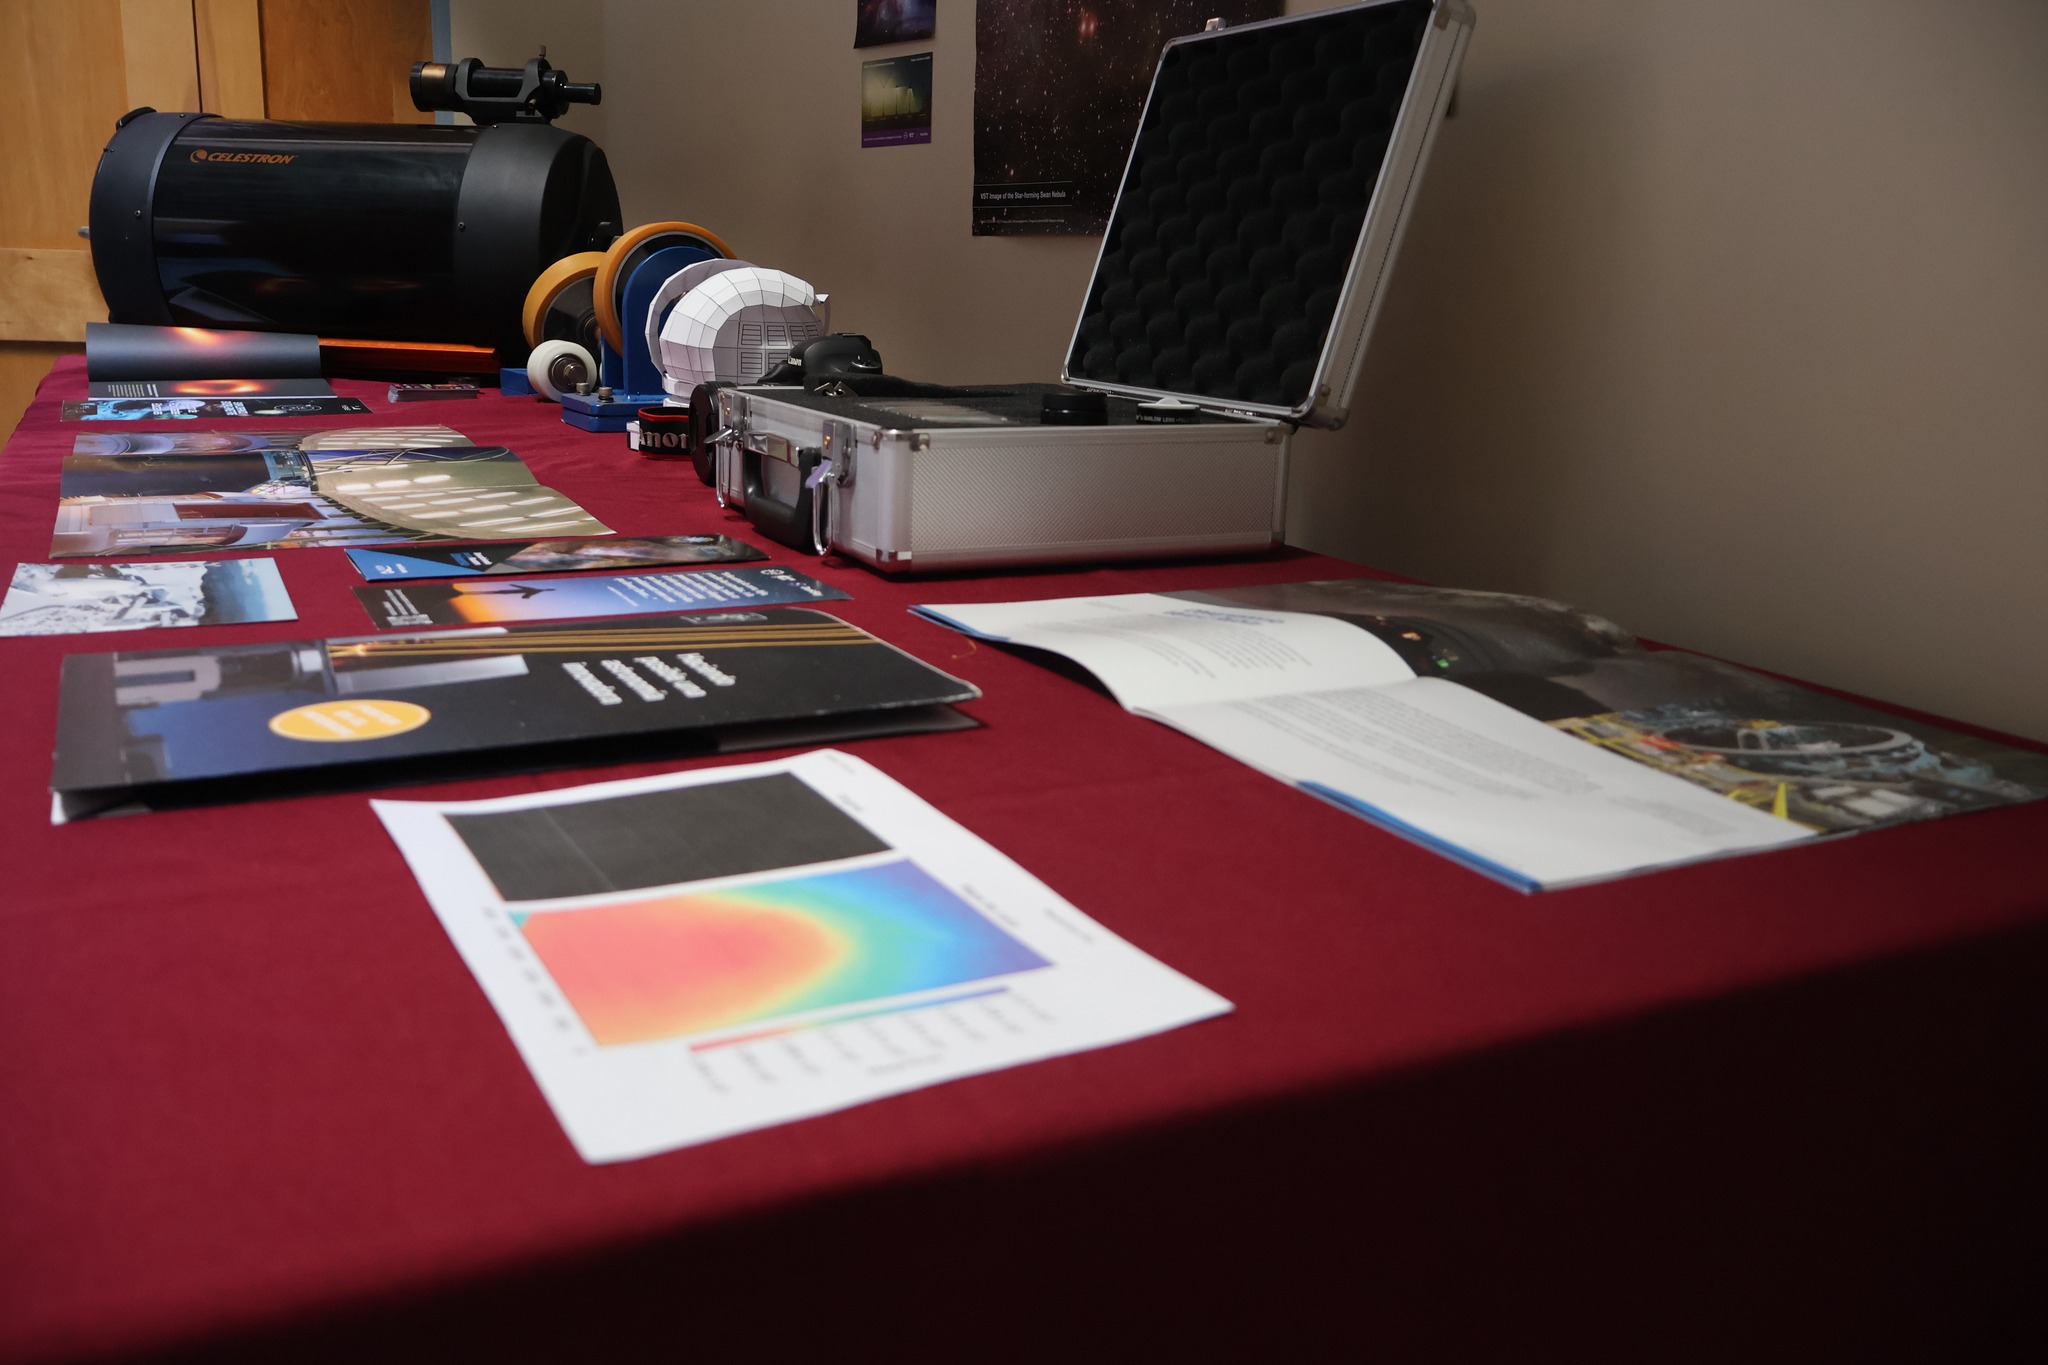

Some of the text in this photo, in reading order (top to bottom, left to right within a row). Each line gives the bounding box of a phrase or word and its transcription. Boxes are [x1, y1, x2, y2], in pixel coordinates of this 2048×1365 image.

[207, 152, 294, 164] CELESTRON
[980, 192, 989, 200] VST
[990, 193, 1002, 201] Image
[1014, 191, 1039, 200] Star-forming
[1040, 190, 1051, 198] Swan
[1051, 190, 1066, 198] Nebula
